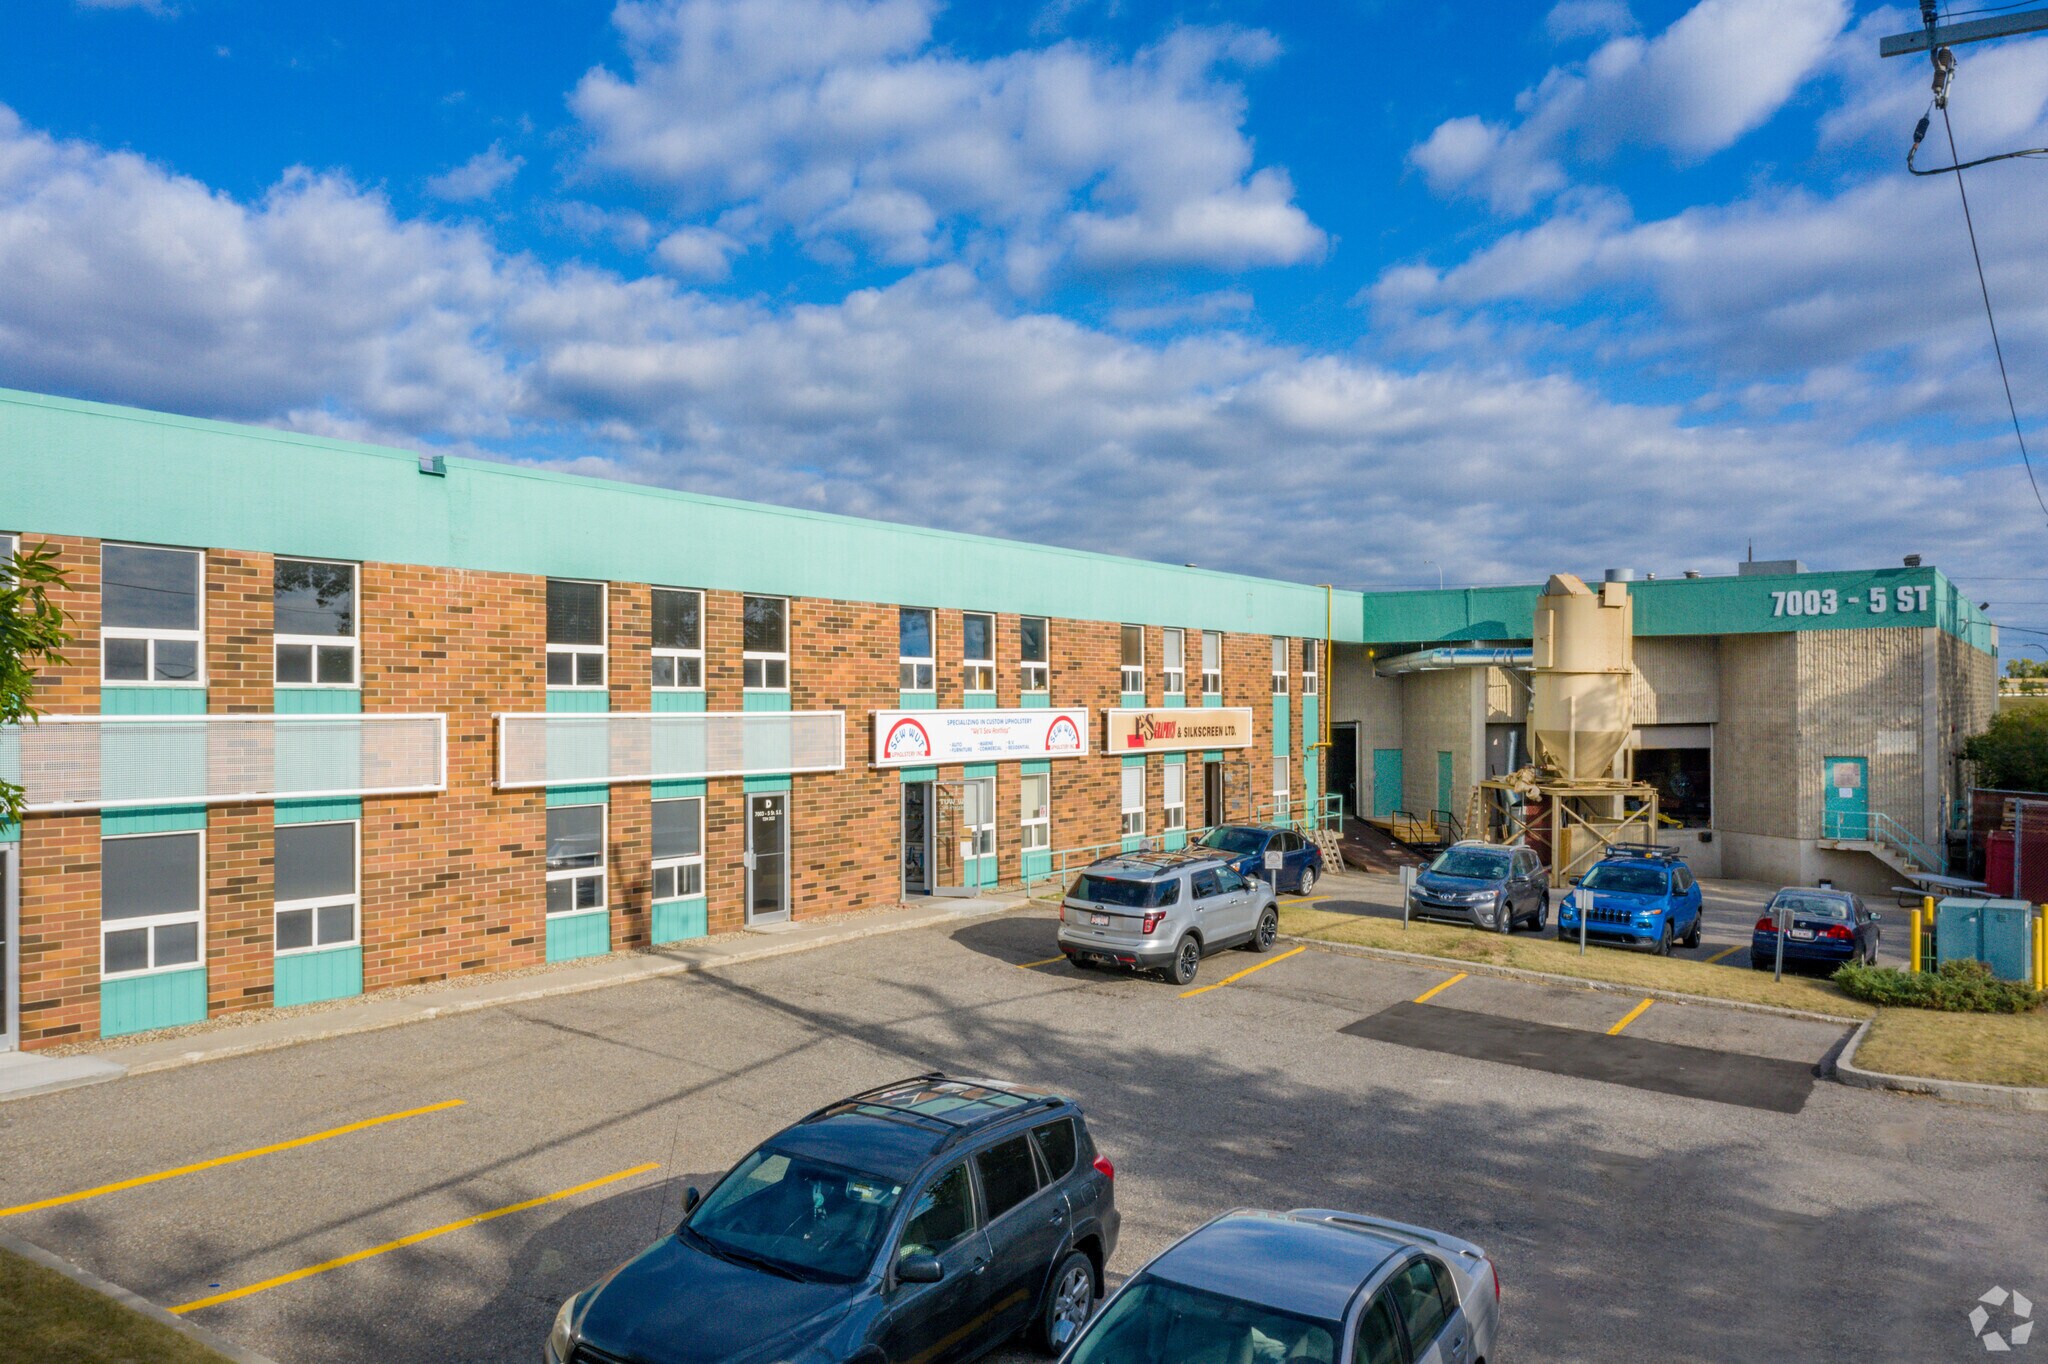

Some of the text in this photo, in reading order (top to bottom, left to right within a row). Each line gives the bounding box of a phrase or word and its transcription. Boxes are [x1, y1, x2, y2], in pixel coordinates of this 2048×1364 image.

[1771, 588, 1838, 617] 7003
[1869, 587, 1887, 613] 5
[1897, 585, 1931, 612] ST
[890, 728, 925, 750] SEW WUT
[1177, 727, 1182, 738] &
[1184, 726, 1223, 738] SILKSCREEN
[1225, 725, 1237, 737] LTD.
[765, 799, 772, 809] D
